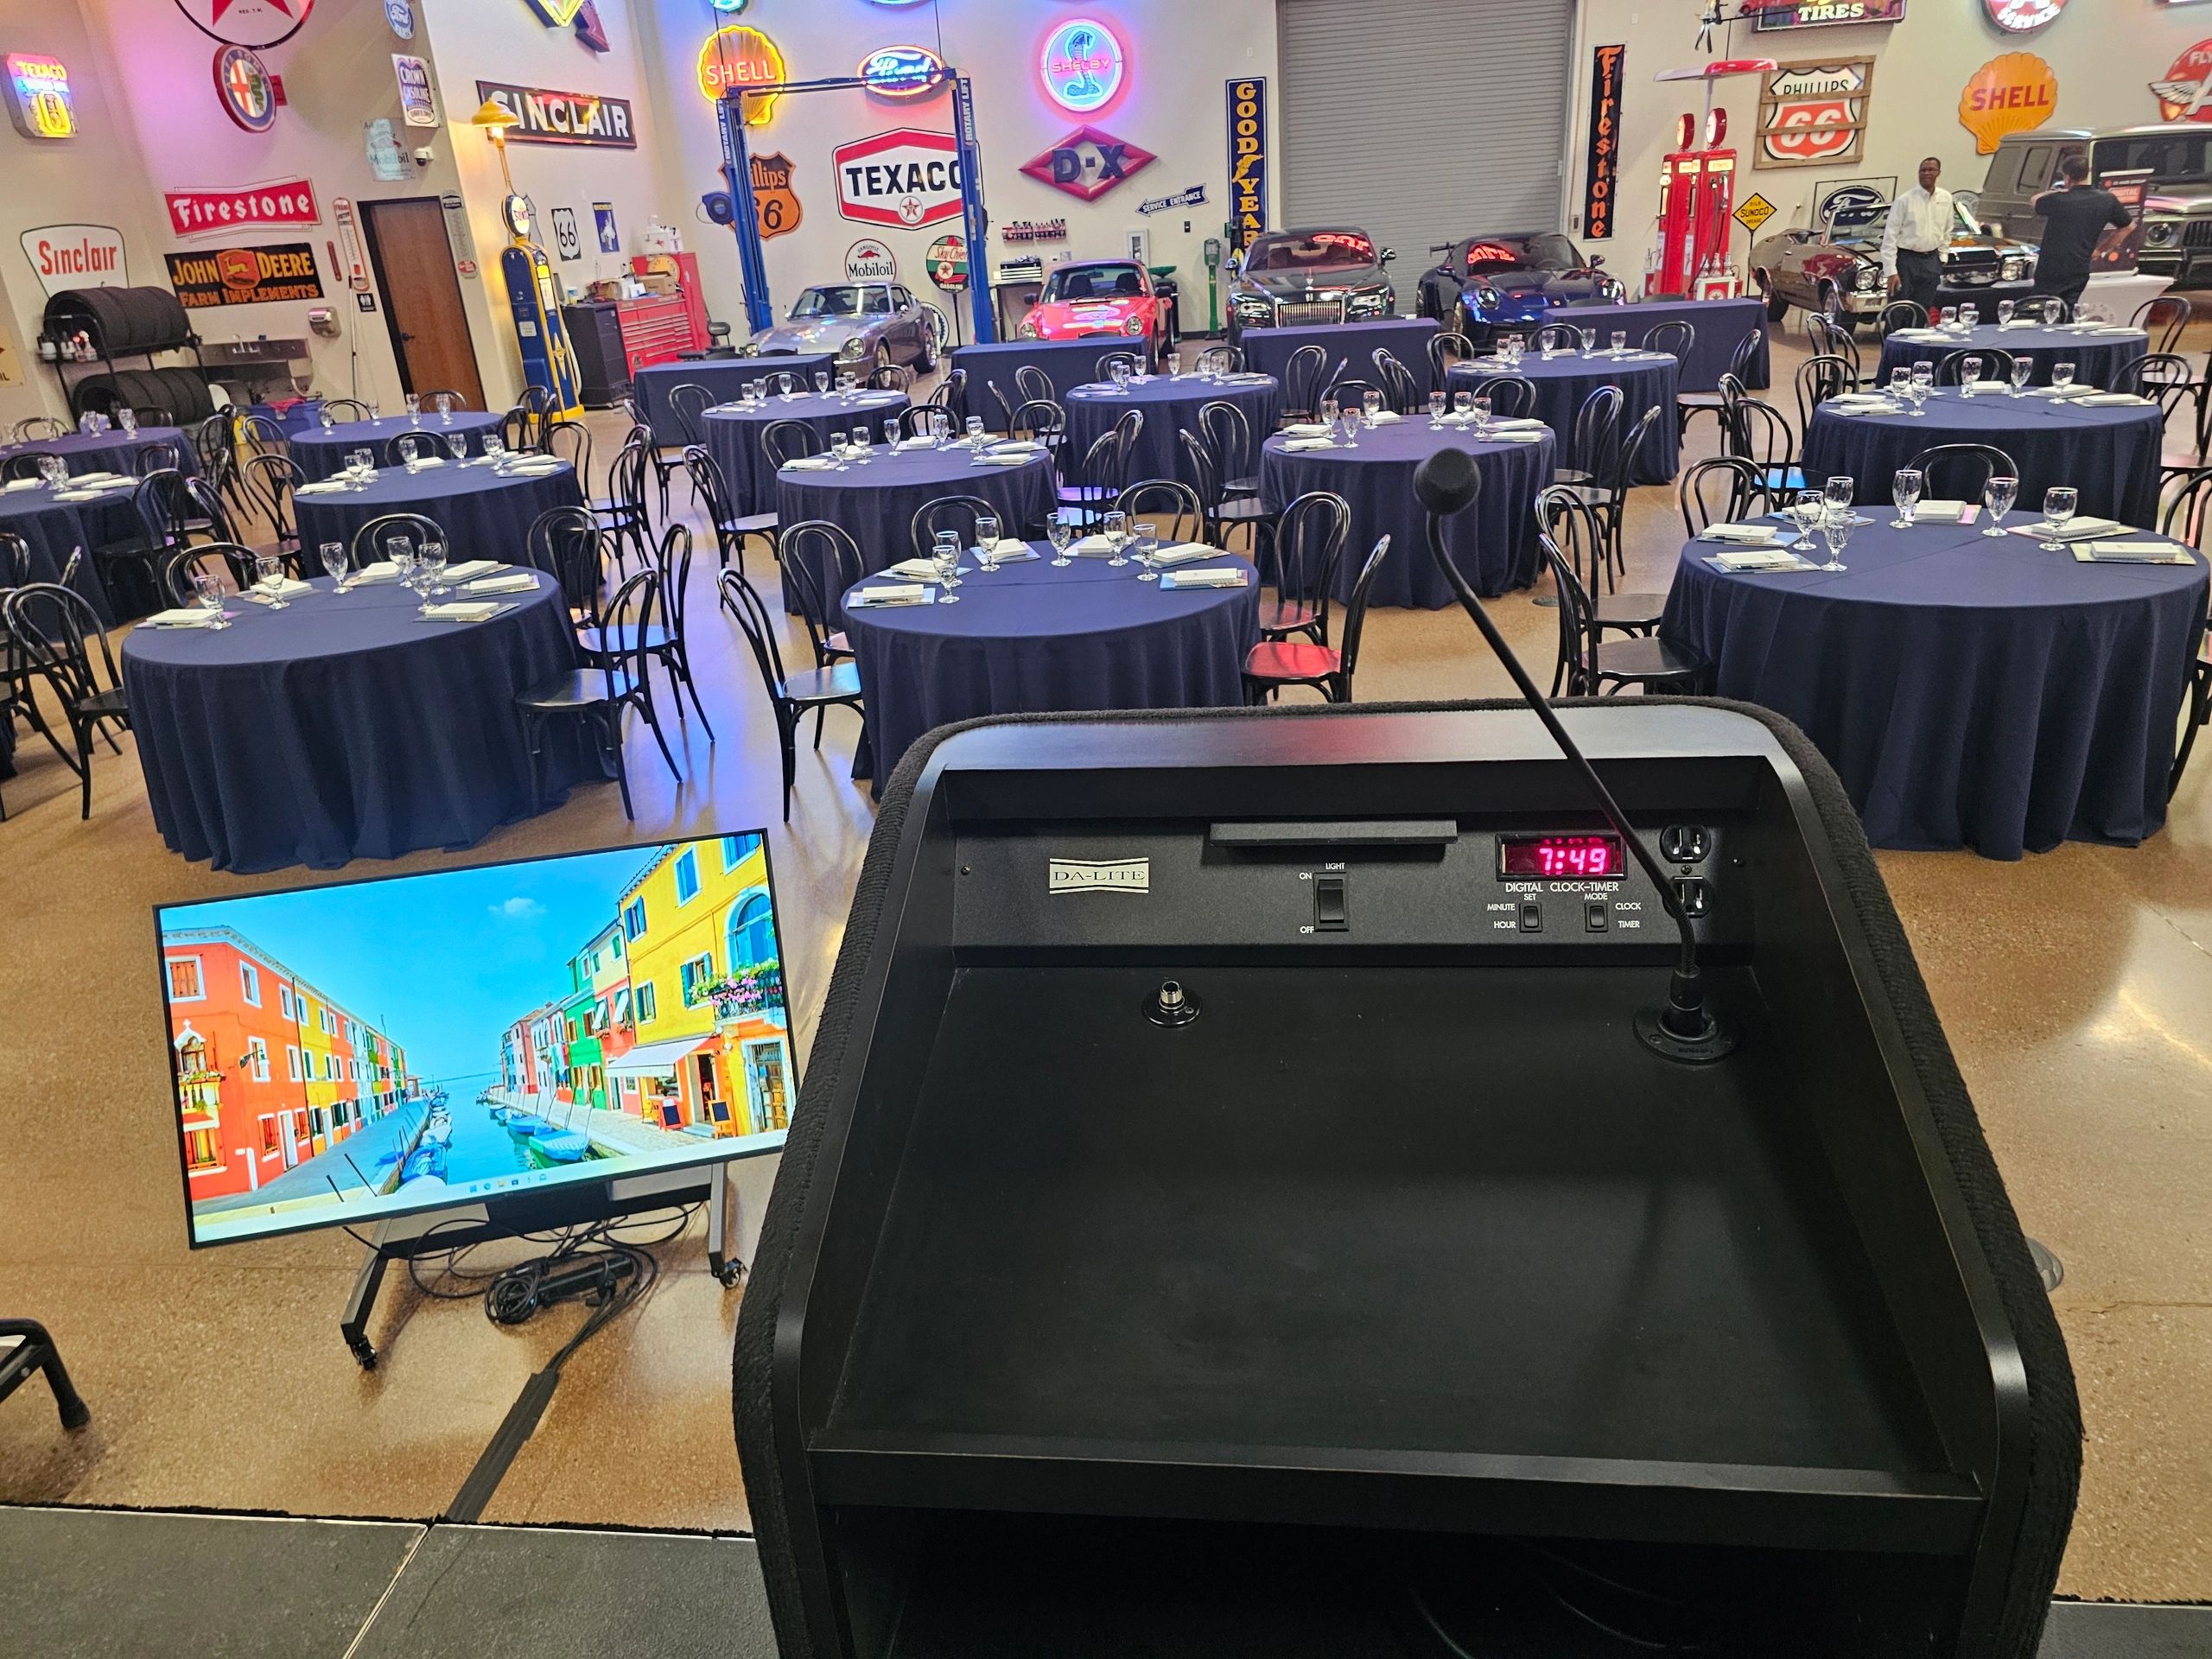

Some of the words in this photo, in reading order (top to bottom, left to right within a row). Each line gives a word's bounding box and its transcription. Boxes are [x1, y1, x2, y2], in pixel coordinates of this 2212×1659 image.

[1798, 3, 1865, 22] TIRES
[1997, 3, 2061, 29] SERVICE
[705, 60, 776, 86] SHELL
[1051, 57, 1110, 73] SHELBY
[960, 79, 969, 100] LIFT
[1783, 79, 1849, 95] PHILLIPS
[1970, 84, 2050, 111] SHELL
[962, 101, 973, 142] ROTARY
[1780, 109, 1841, 148] 66
[1591, 46, 1623, 238] Firestone
[750, 160, 787, 194] illips
[173, 193, 310, 227] Firestone
[1142, 199, 1167, 213] SERVICE
[1169, 190, 1202, 206] ENTRANCE
[1739, 206, 1770, 218] SUNOCO
[559, 221, 576, 248] 66
[38, 238, 118, 275] Sinclair
[934, 246, 949, 259] Sky
[174, 258, 221, 286] JOHN
[256, 251, 315, 279] DEERE
[848, 261, 893, 277] Mobiloil
[179, 289, 221, 308] FARM
[222, 283, 319, 304] IMPLEMENTS
[1539, 848, 1606, 873] 7:49
[1054, 871, 1145, 880] DA-LITE
[1505, 883, 1543, 893] DIGITAL
[1549, 882, 1619, 892] CLOCK-TIMER
